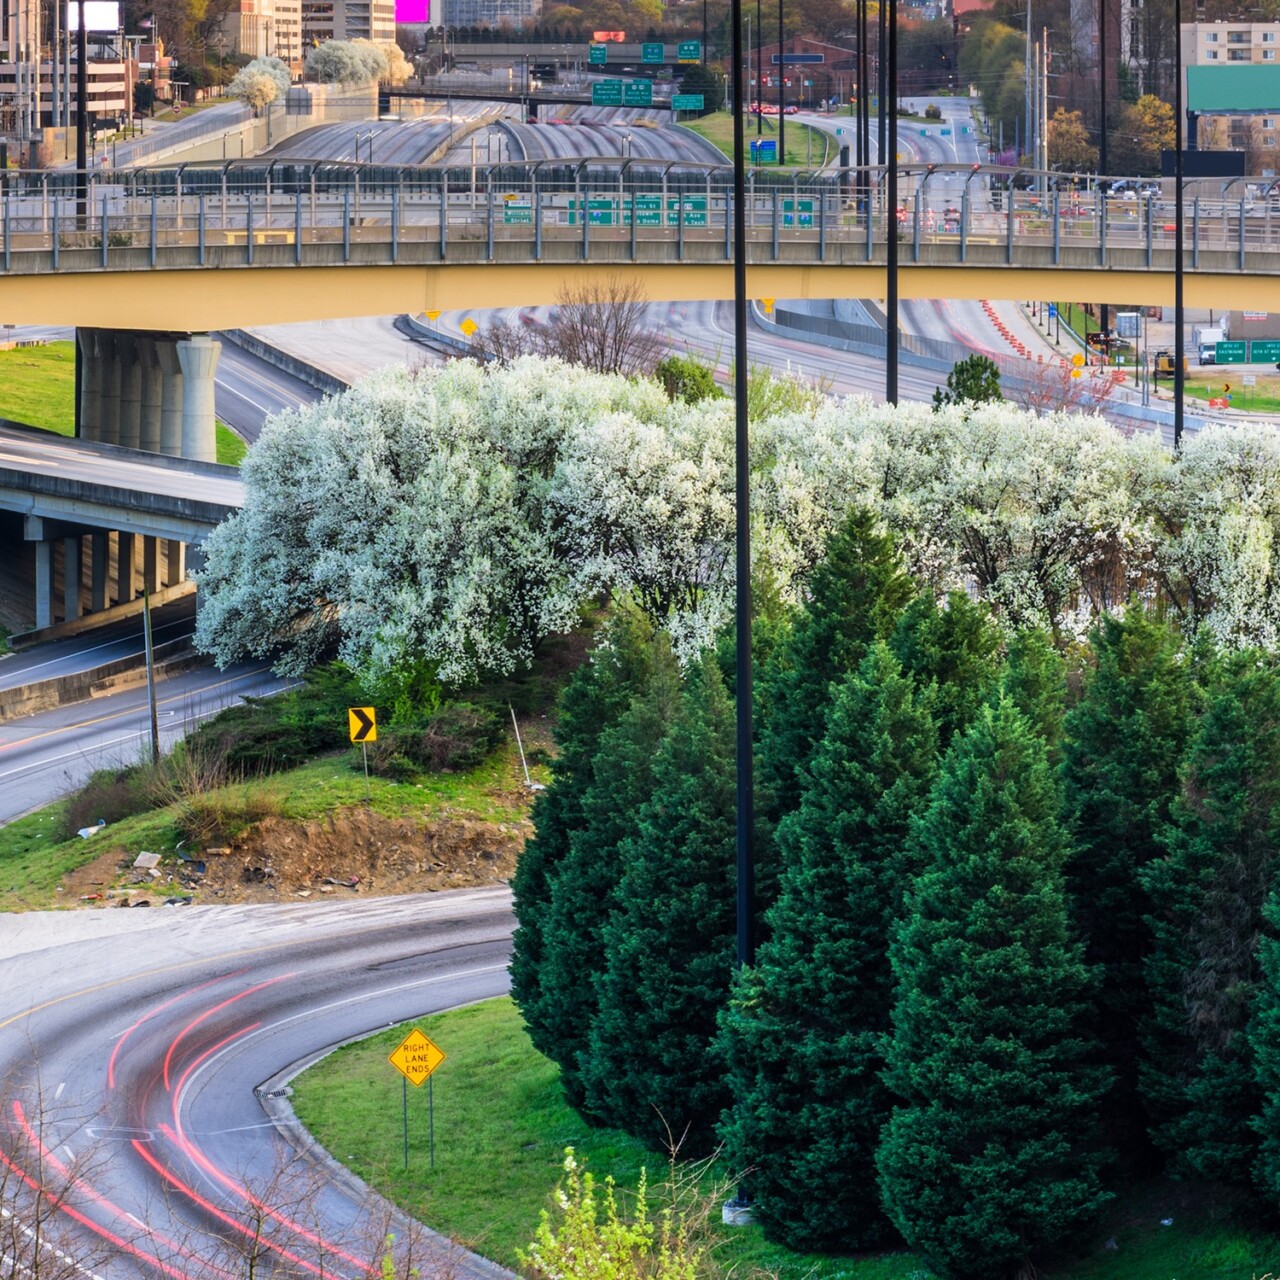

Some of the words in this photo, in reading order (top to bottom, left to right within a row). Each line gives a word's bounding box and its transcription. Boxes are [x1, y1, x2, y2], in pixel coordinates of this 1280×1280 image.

[403, 1043, 430, 1052] RIGHT
[405, 1054, 428, 1063] LANE
[406, 1065, 430, 1073] ENDS
